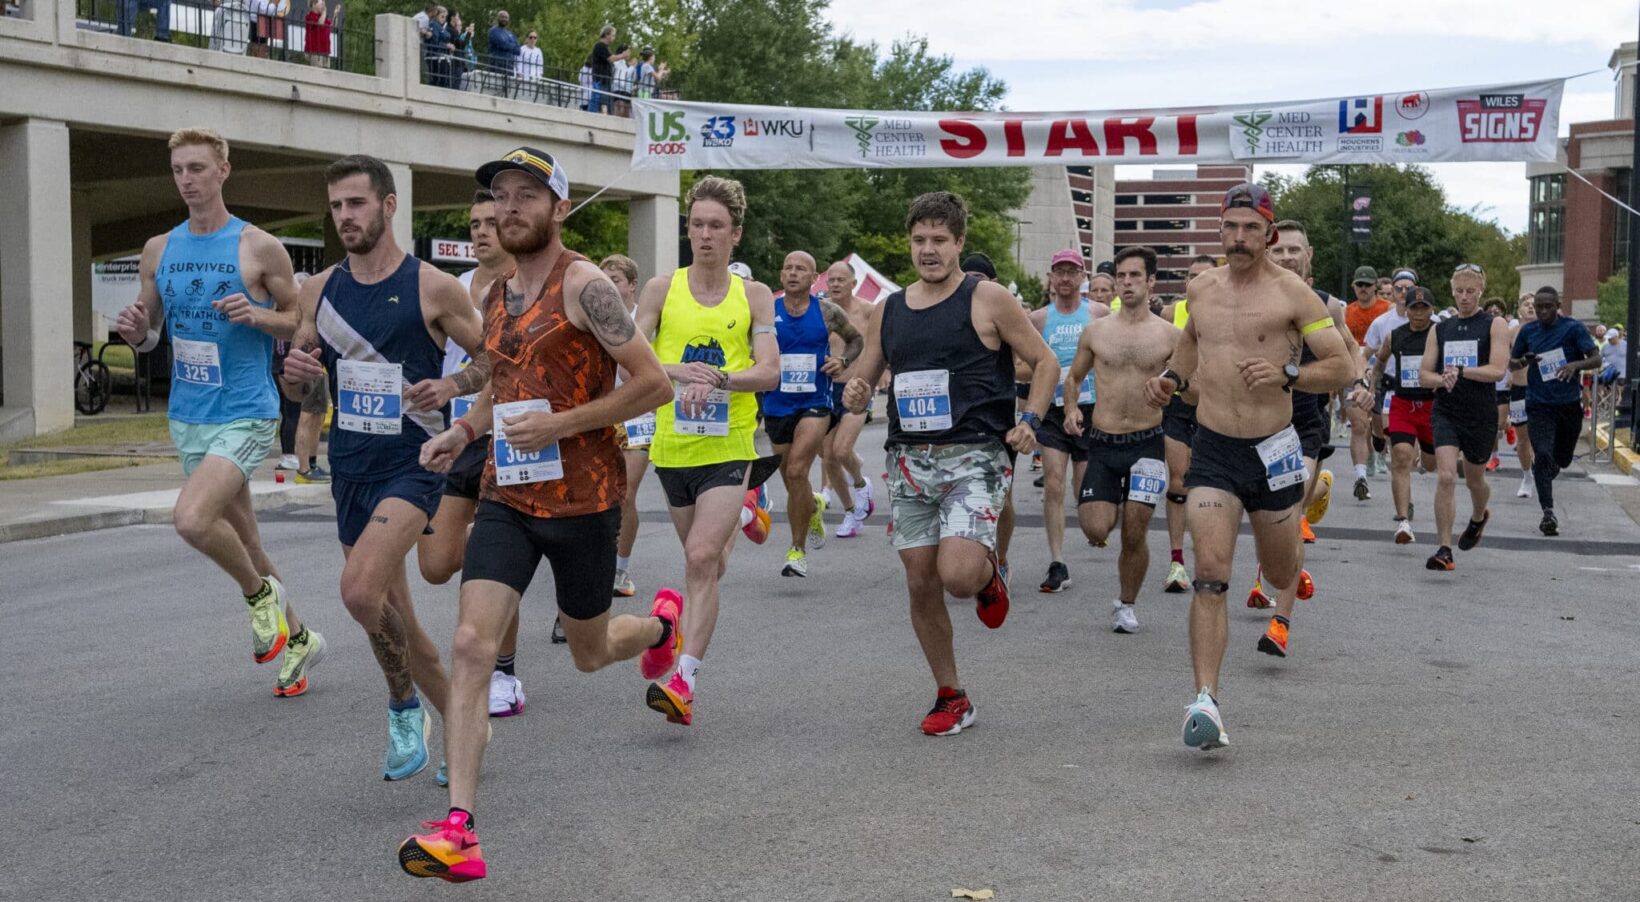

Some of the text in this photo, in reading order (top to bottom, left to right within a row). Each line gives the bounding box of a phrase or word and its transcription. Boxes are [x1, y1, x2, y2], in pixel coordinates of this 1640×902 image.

[1485, 96, 1519, 107] WILES
[883, 119, 912, 130] MED
[1278, 112, 1311, 124] MED
[648, 111, 690, 142] US.
[707, 116, 736, 139] 13
[761, 119, 803, 138] WKU
[1266, 125, 1324, 138] CENTER
[1465, 112, 1536, 139] SIGNS
[875, 131, 926, 142] CENTER
[648, 143, 686, 155] FOODS
[876, 145, 926, 156] HEALTH
[1266, 140, 1323, 153] HEALTH
[438, 243, 461, 257] SEC.
[161, 262, 236, 275] I SURVIVED
[184, 364, 209, 381] 325
[789, 371, 809, 383] 222
[352, 394, 384, 416] 492
[909, 398, 936, 416] 404
[1138, 478, 1160, 492] 490
